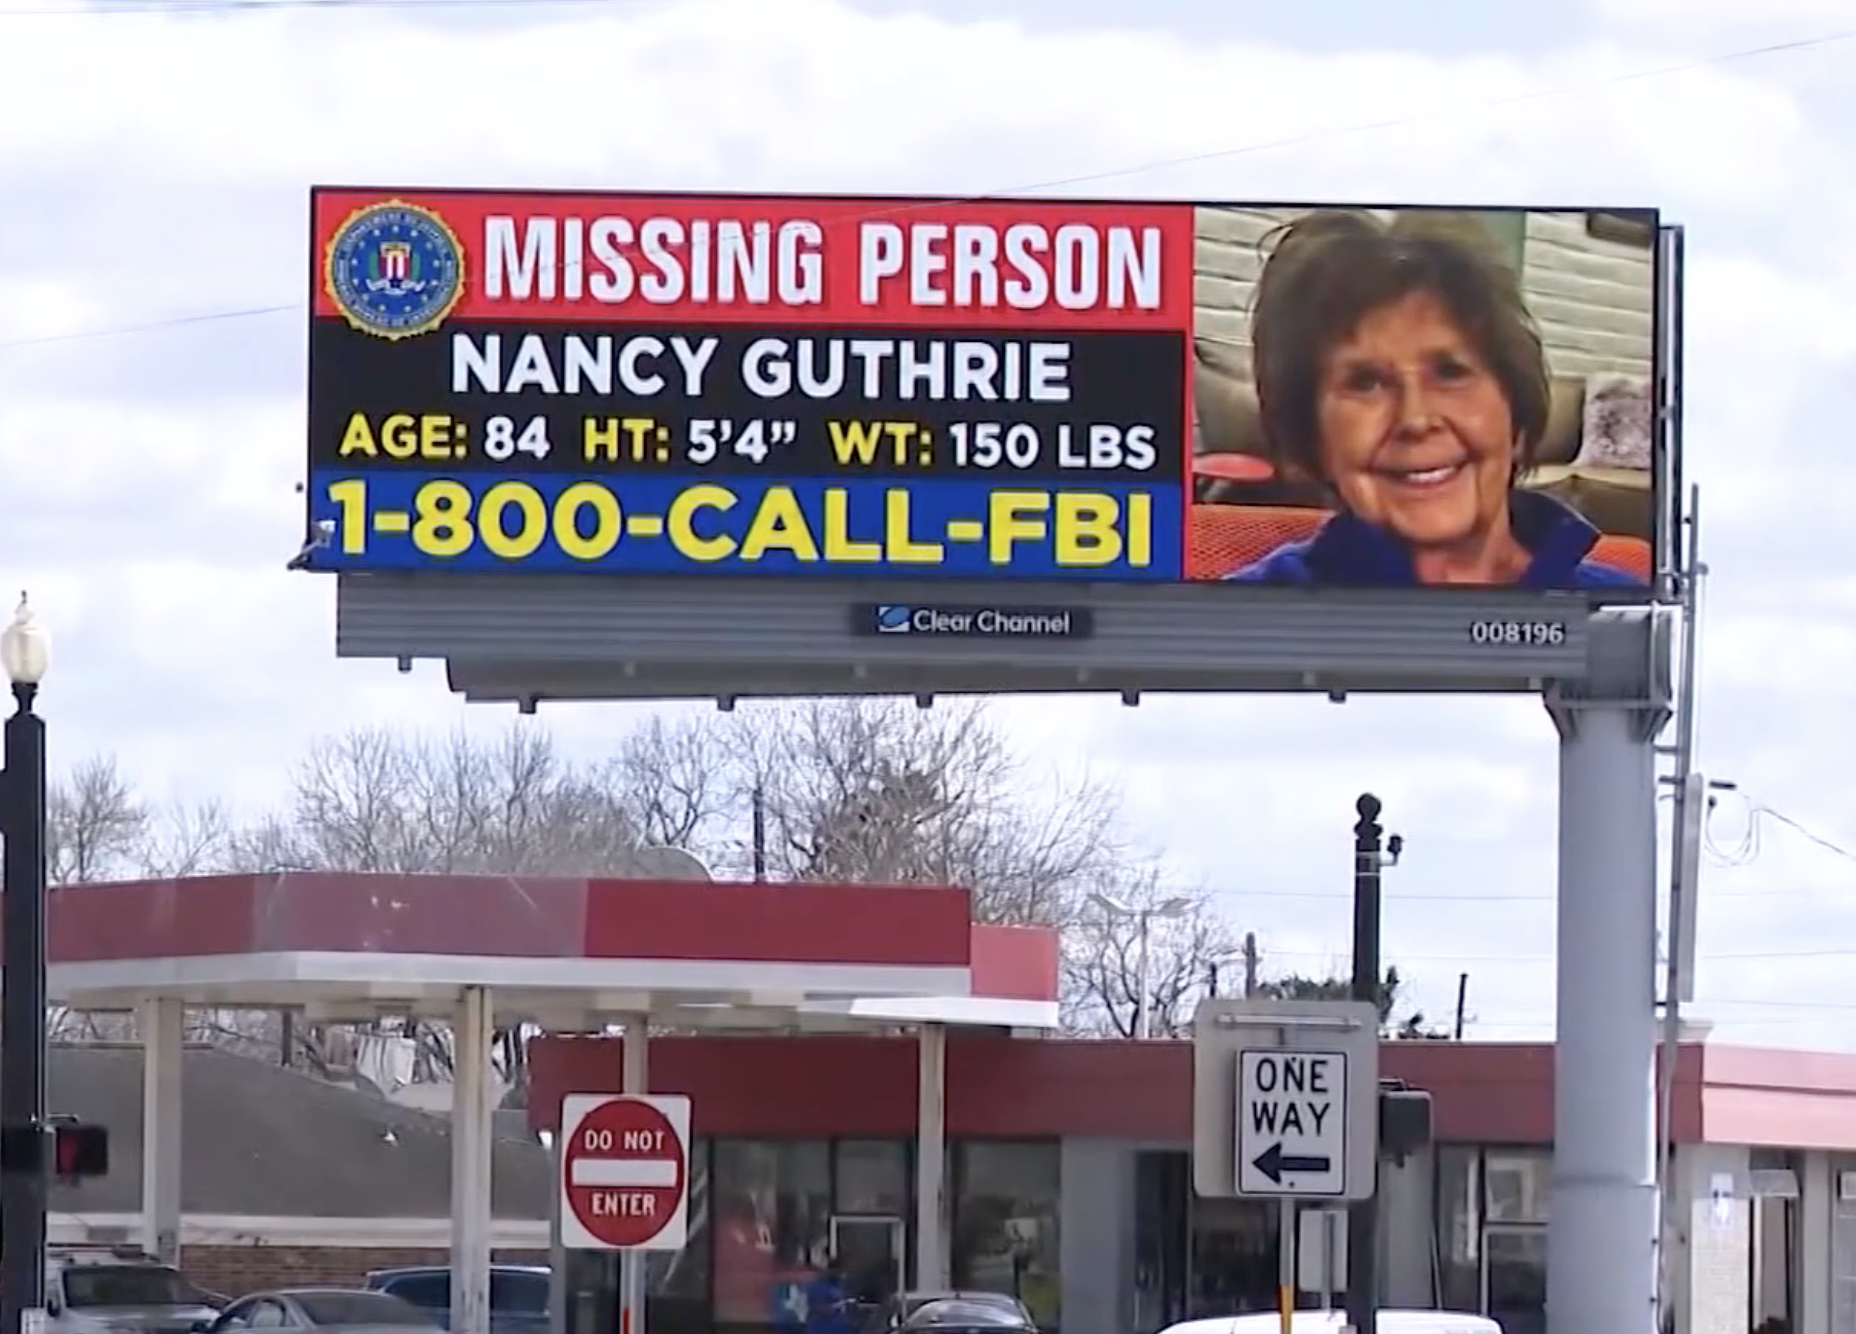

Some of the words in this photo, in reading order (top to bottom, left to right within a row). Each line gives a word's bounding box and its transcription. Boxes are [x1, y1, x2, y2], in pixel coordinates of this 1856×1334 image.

[484, 216, 823, 305] MISSING
[859, 223, 1161, 310] PERSON
[452, 334, 719, 396] NANCY
[742, 338, 1071, 402] GUTHRIE
[339, 413, 467, 458] AGE:
[484, 416, 551, 460] 84
[583, 418, 669, 461] HT:
[828, 420, 934, 466] WT:
[949, 422, 1039, 468] 150
[1058, 424, 1156, 471] LBS
[328, 480, 1151, 567] 1-800-CALL-FBI
[913, 610, 972, 632] Clear
[977, 611, 1070, 634] Channel
[1472, 622, 1564, 643] 008196
[1256, 1058, 1328, 1093] ONE
[1253, 1101, 1331, 1136] WAY
[584, 1129, 613, 1150] DO
[624, 1130, 665, 1151] NOT
[592, 1192, 656, 1216] ENTER
